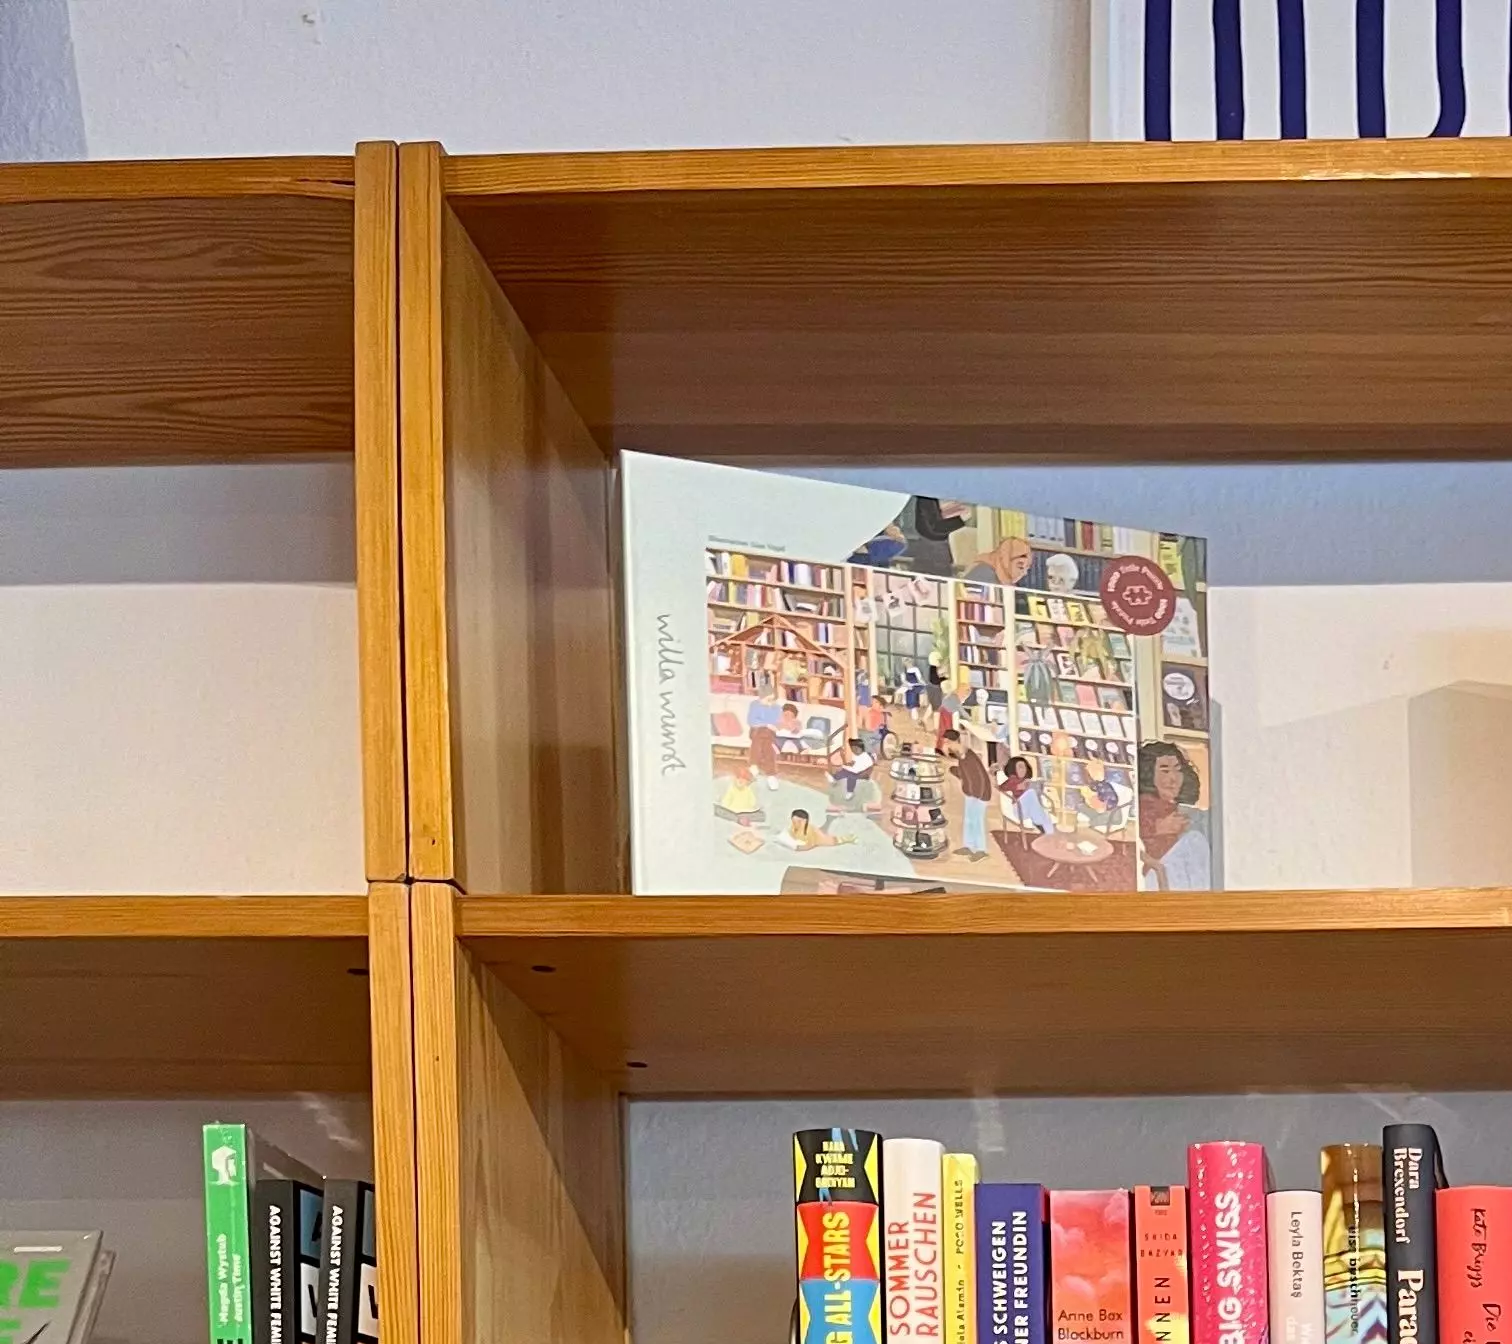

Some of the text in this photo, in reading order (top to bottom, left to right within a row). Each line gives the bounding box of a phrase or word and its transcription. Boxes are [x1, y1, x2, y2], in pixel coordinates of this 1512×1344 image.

[269, 1205, 281, 1268] AGAINST
[270, 1271, 281, 1310] WHITE
[822, 1210, 853, 1329] ALL-STARS
[888, 1220, 911, 1337] SOMMER
[916, 1192, 938, 1337] RAUSCHEN
[991, 1220, 1010, 1337] SCHWEIGEN
[1012, 1210, 1029, 1313] FREUNDIN
[1215, 1190, 1243, 1294] SWISS
